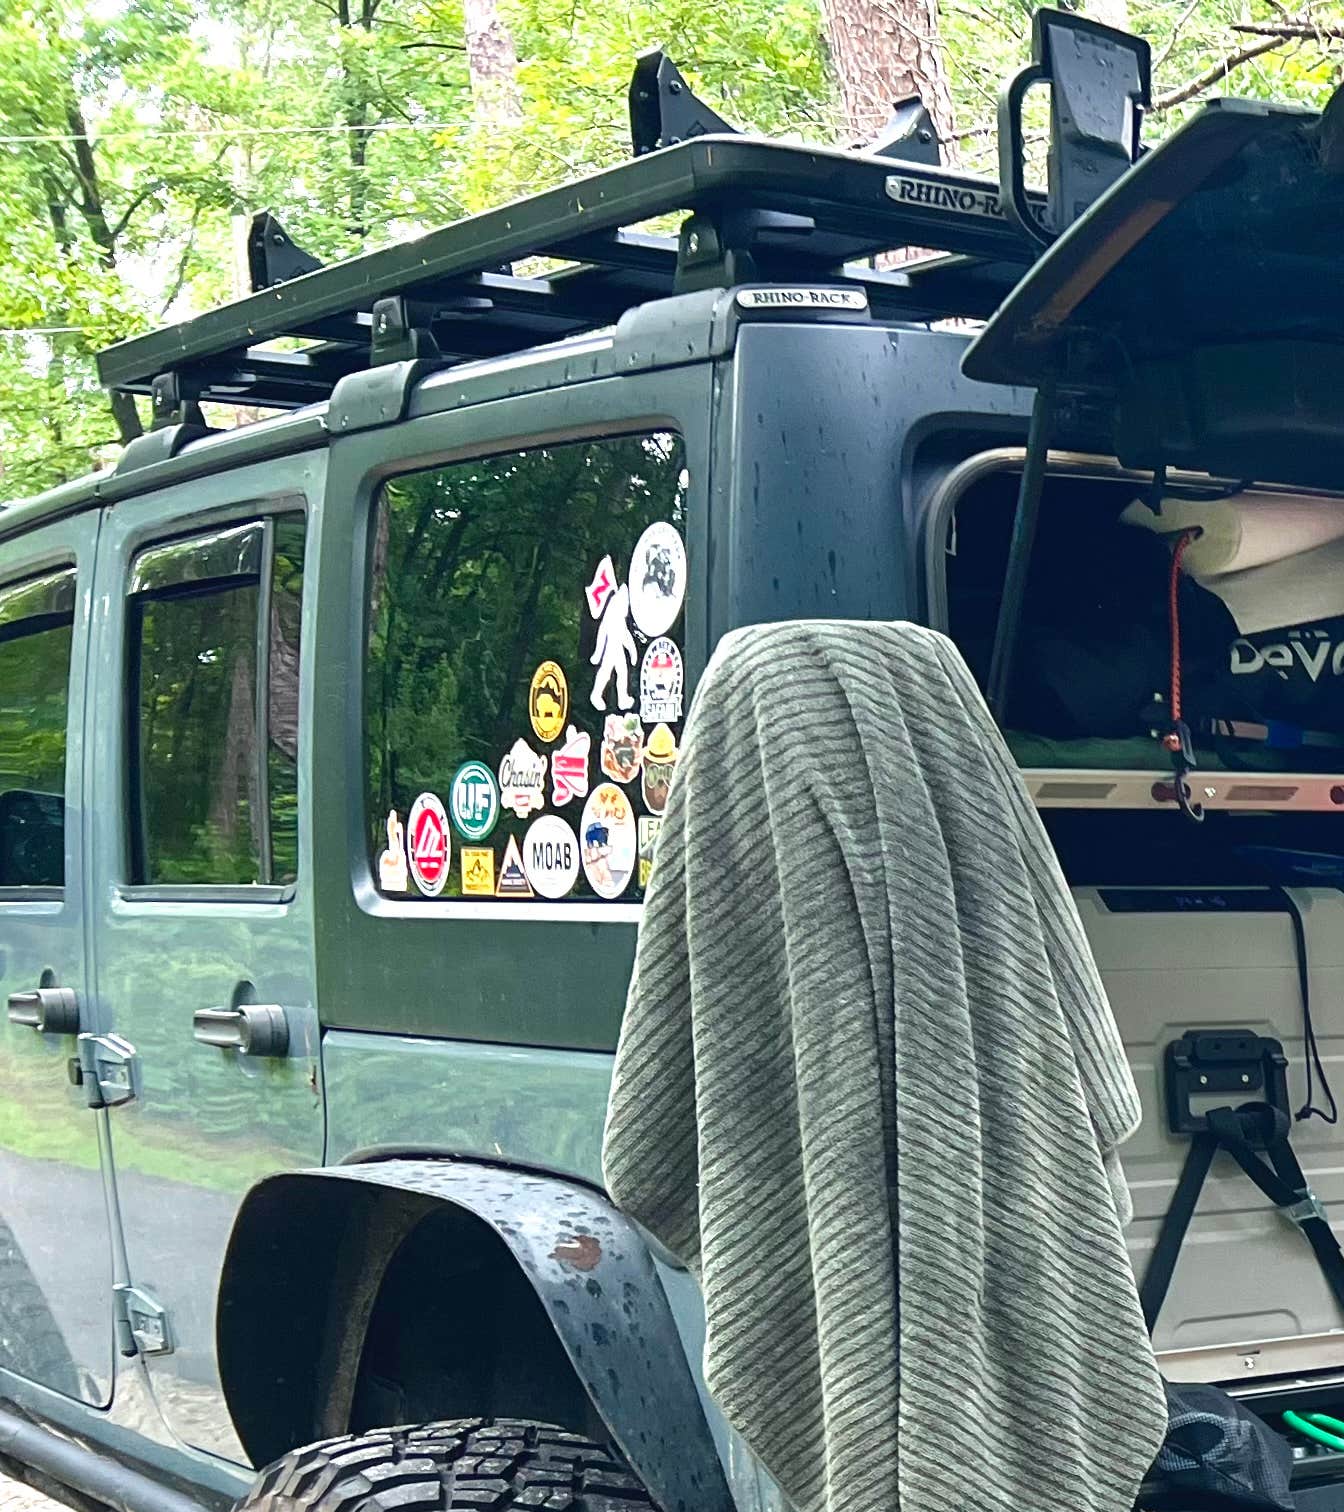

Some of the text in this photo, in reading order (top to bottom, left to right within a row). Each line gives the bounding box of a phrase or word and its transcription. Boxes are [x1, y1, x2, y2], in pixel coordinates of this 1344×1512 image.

[899, 180, 1047, 224] RHINO-RK
[751, 291, 851, 304] RHINO-RACK
[532, 842, 572, 870] MOAB
